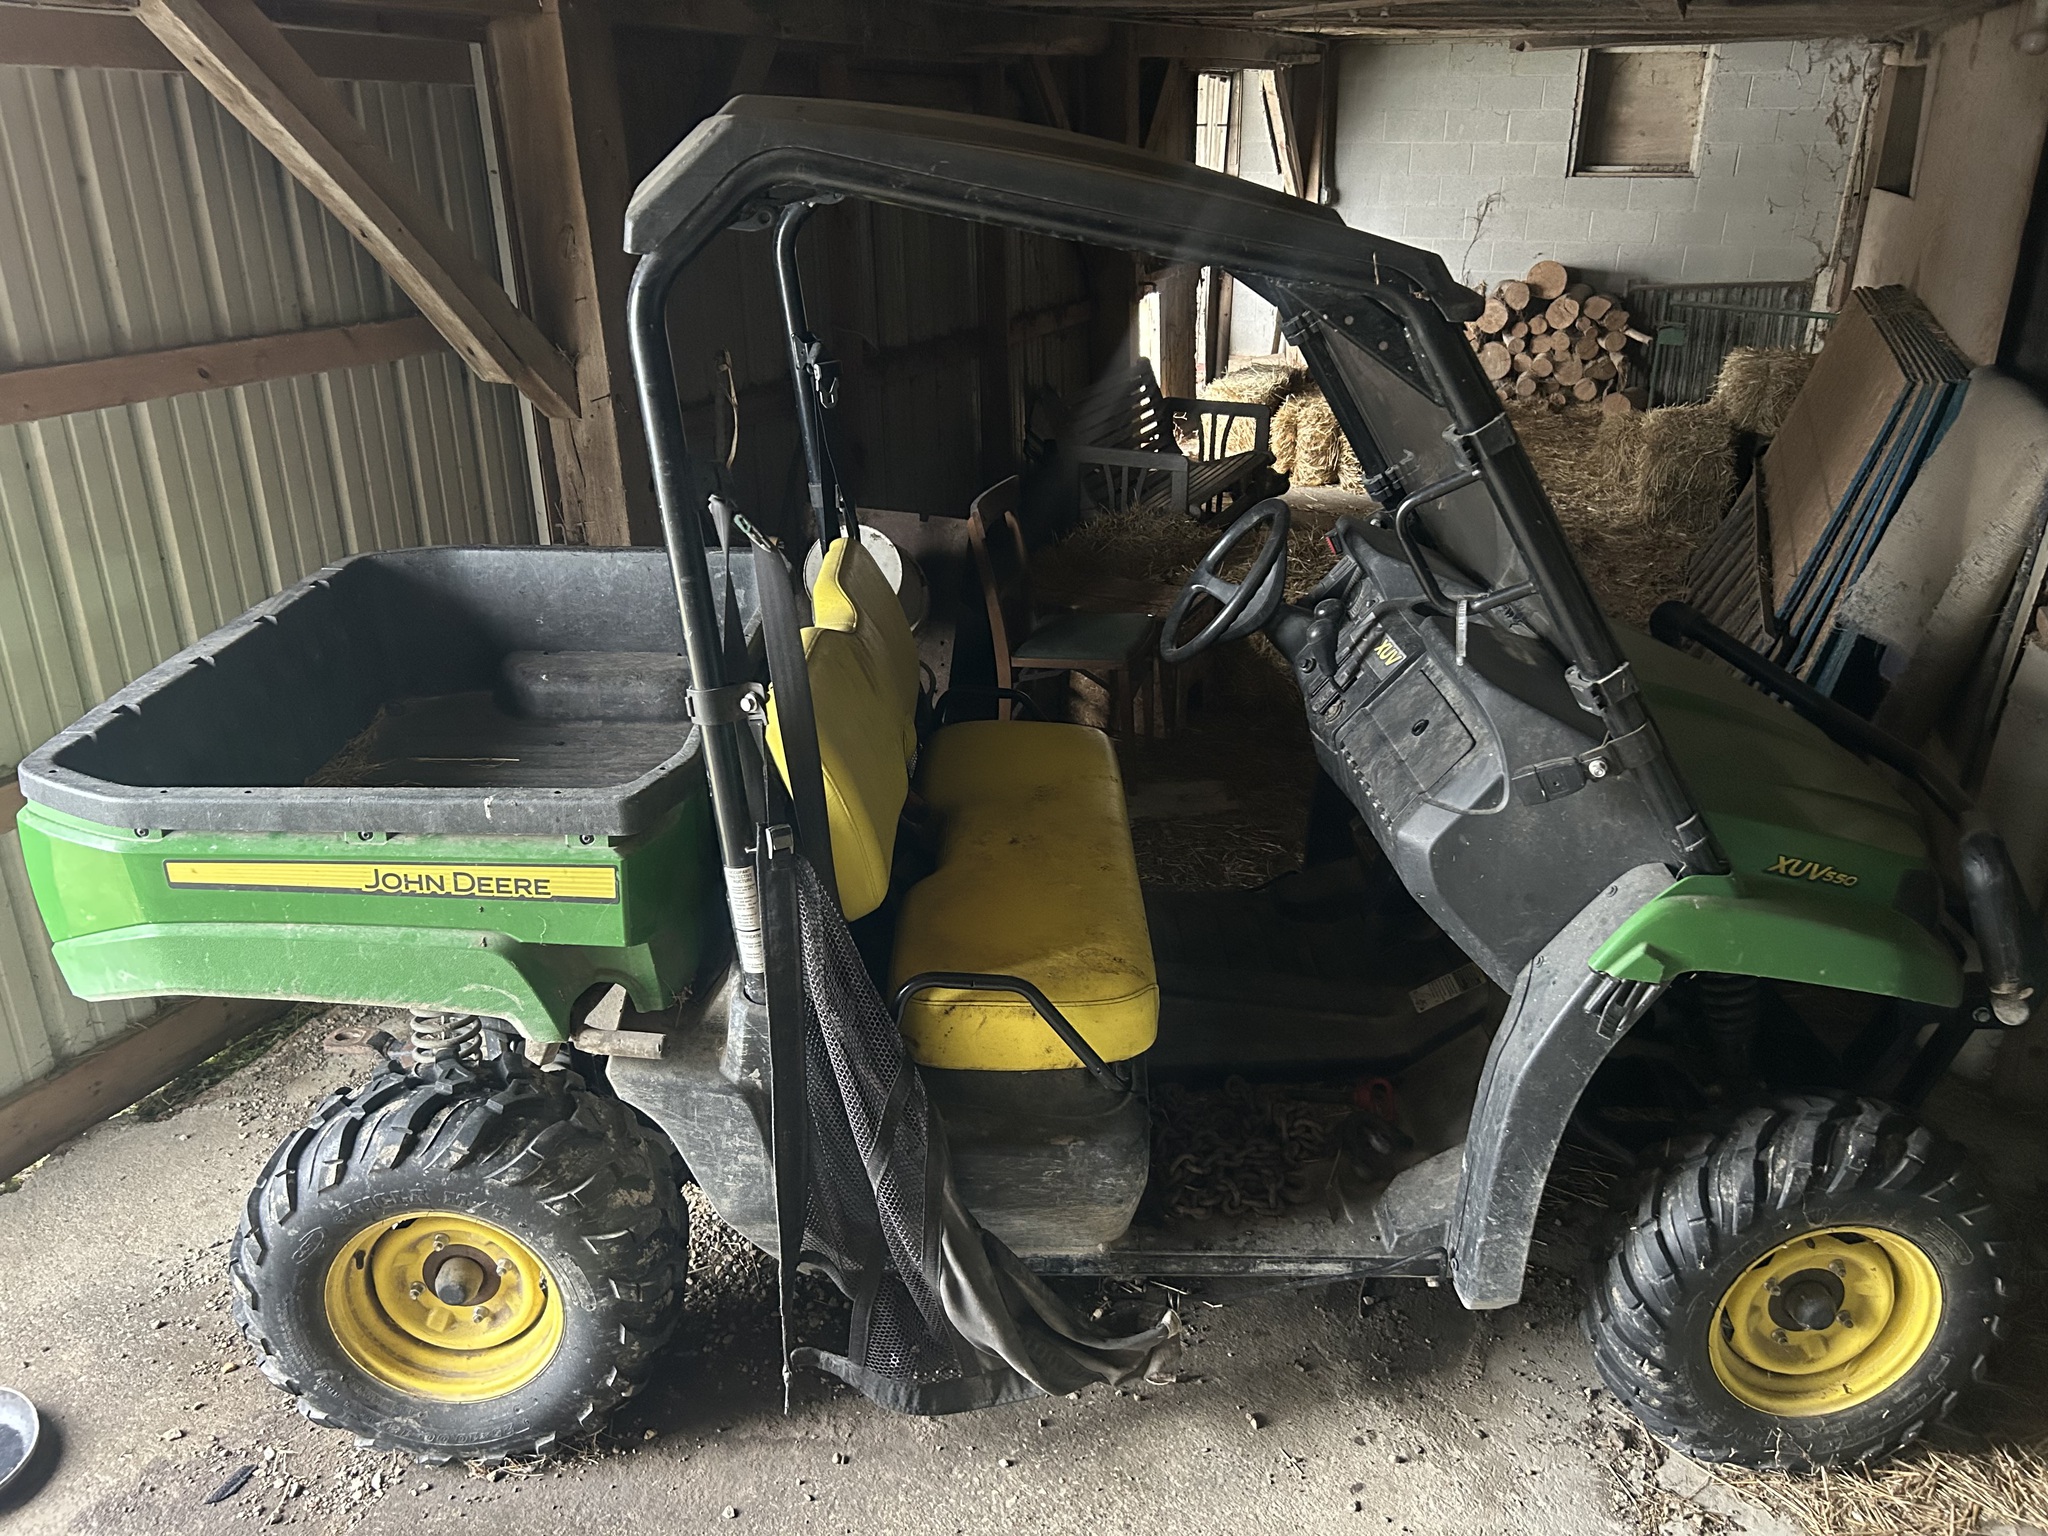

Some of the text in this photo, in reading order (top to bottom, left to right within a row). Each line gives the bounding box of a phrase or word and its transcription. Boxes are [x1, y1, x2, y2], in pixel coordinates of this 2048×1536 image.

[1373, 638, 1403, 667] XUV
[364, 868, 552, 896] JOHN DEERE
[1766, 855, 1858, 886] XUV550
